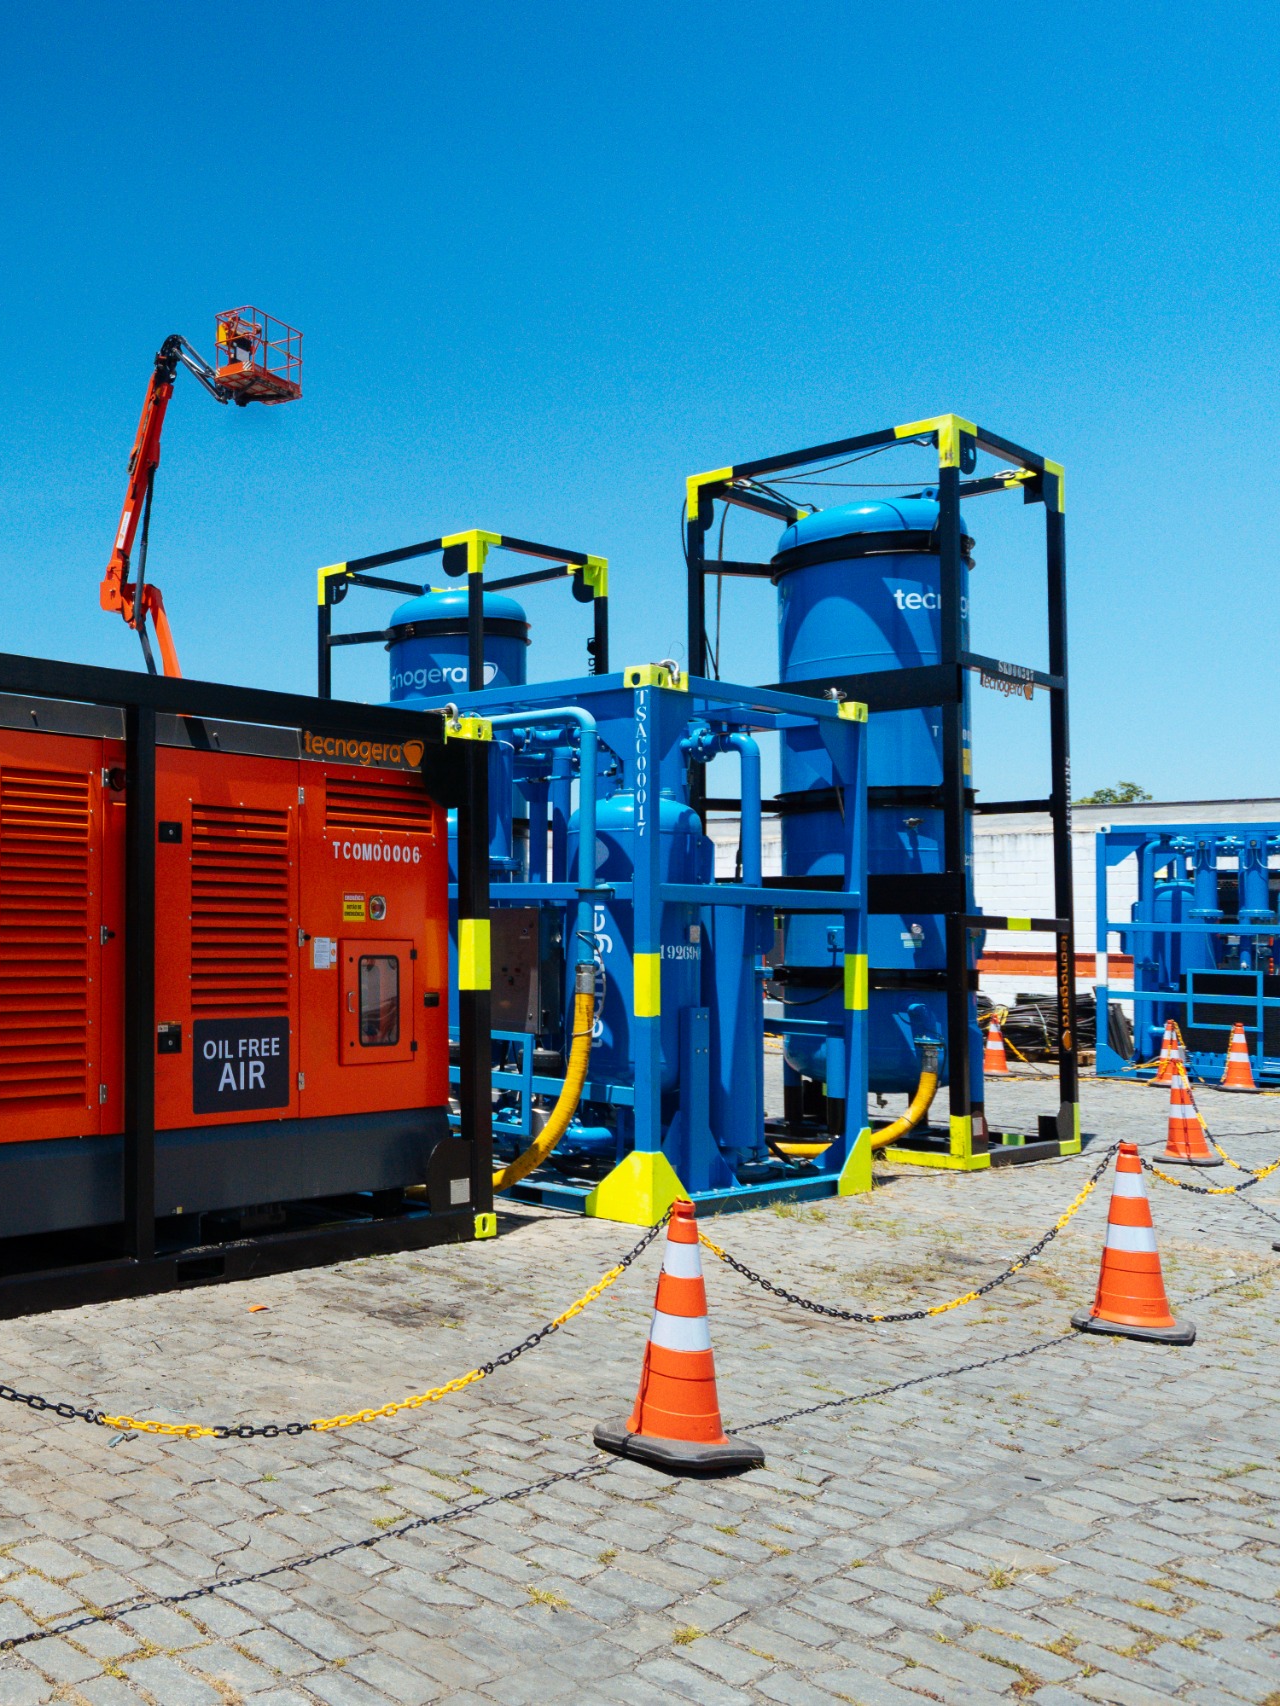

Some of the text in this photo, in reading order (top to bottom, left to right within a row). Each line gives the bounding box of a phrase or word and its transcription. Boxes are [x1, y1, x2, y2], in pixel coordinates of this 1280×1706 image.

[304, 730, 403, 765] tecnogera
[635, 689, 648, 837] TSAC00017
[332, 841, 420, 864] TCOM00006
[203, 1037, 280, 1060] OIL FREE
[218, 1061, 266, 1092] AIR
